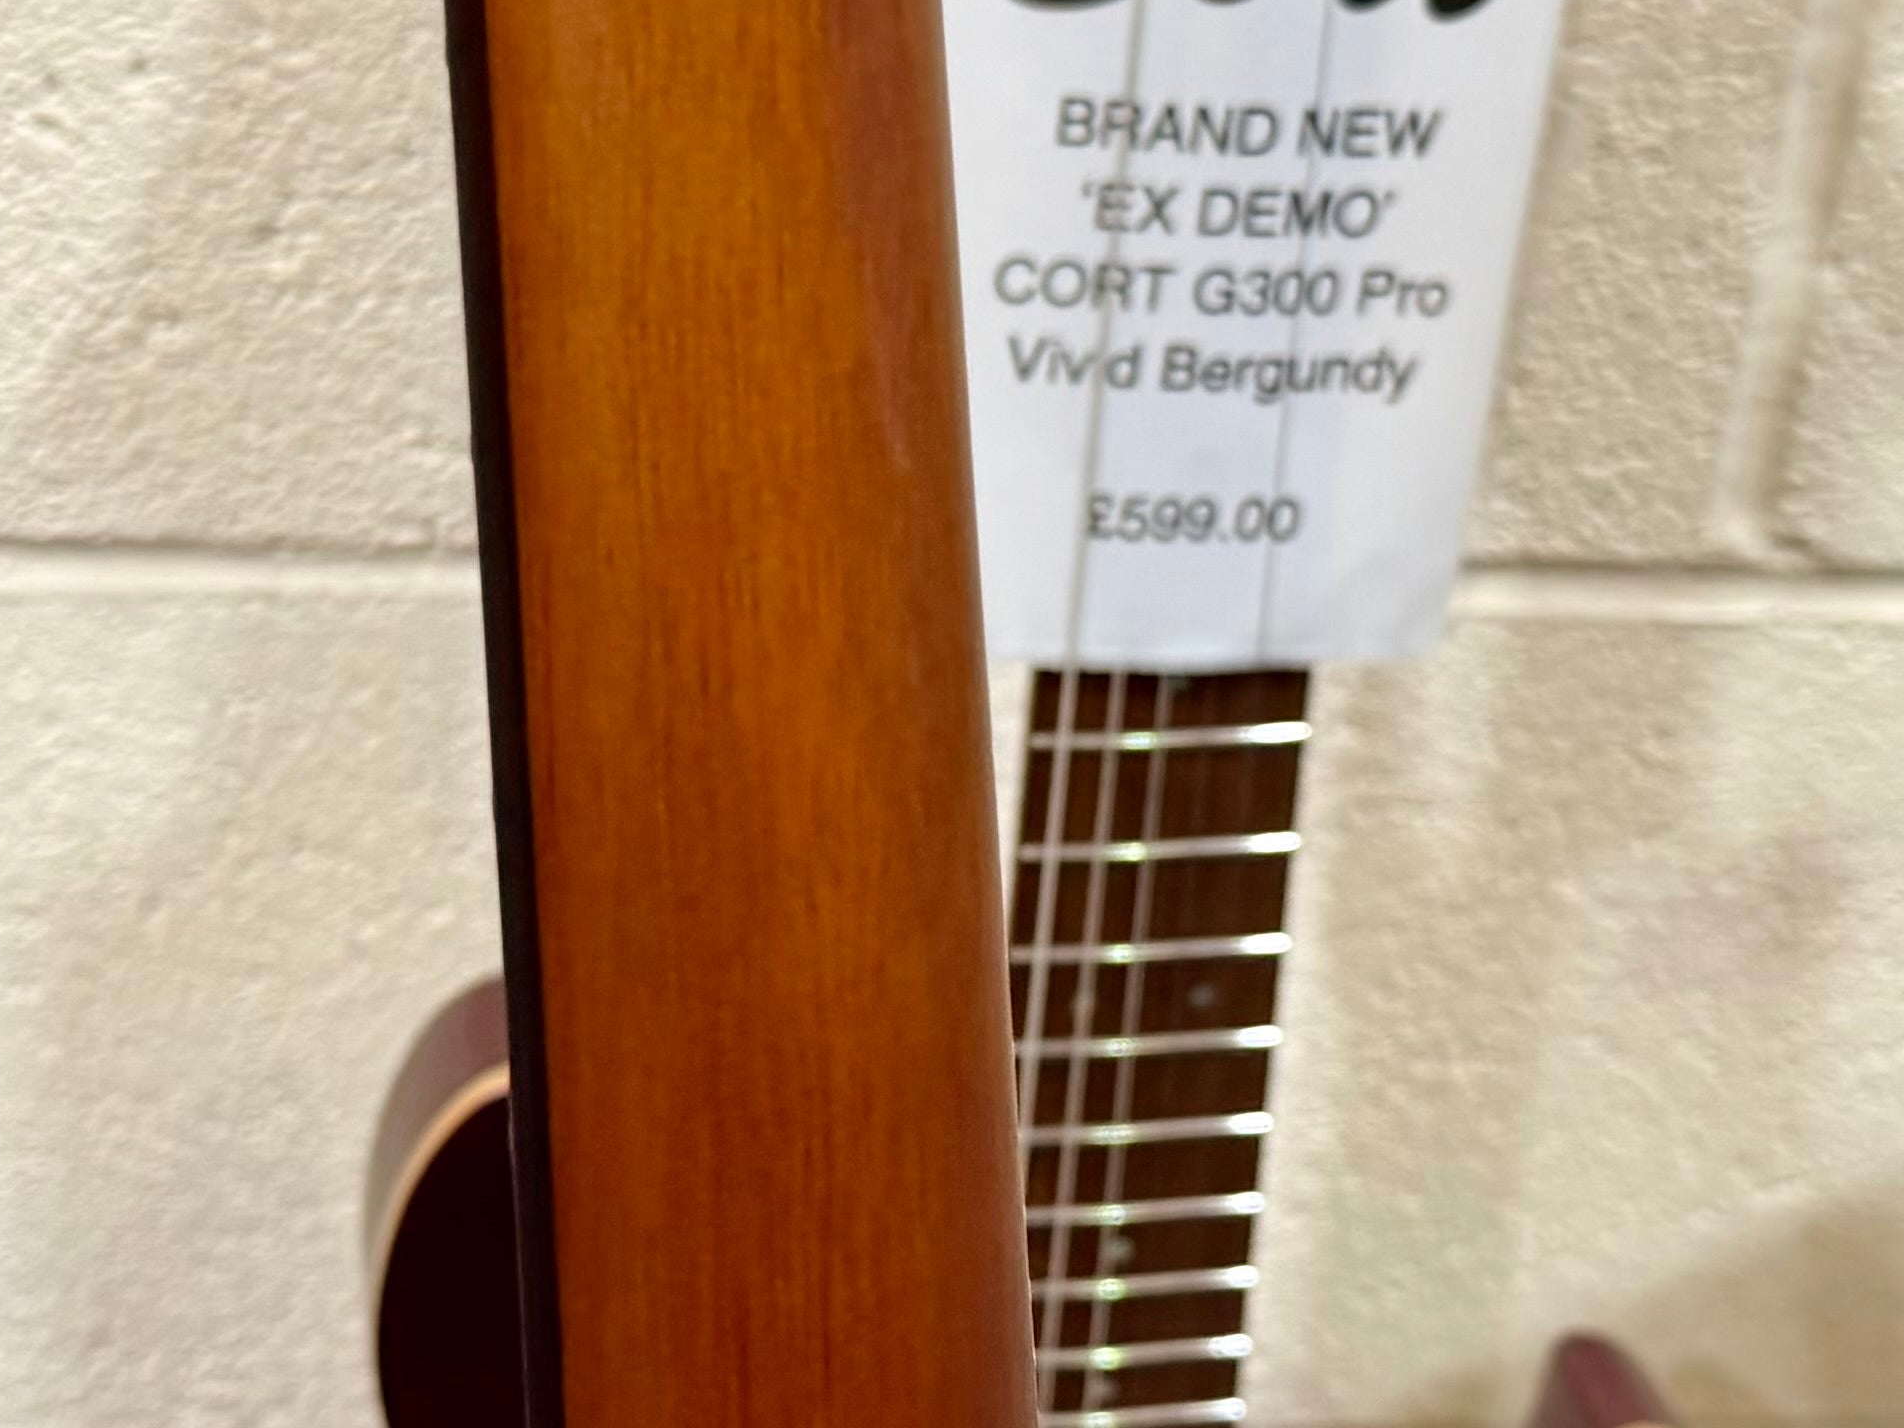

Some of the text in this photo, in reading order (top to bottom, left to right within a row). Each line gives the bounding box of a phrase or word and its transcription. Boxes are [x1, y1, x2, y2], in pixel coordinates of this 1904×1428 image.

[1056, 96, 1443, 159] BRAND NEW
[993, 256, 1451, 318] CORT G300 Pro
[1007, 335, 1418, 407] Vivd Bergundy
[1085, 493, 1302, 544] £599.00
